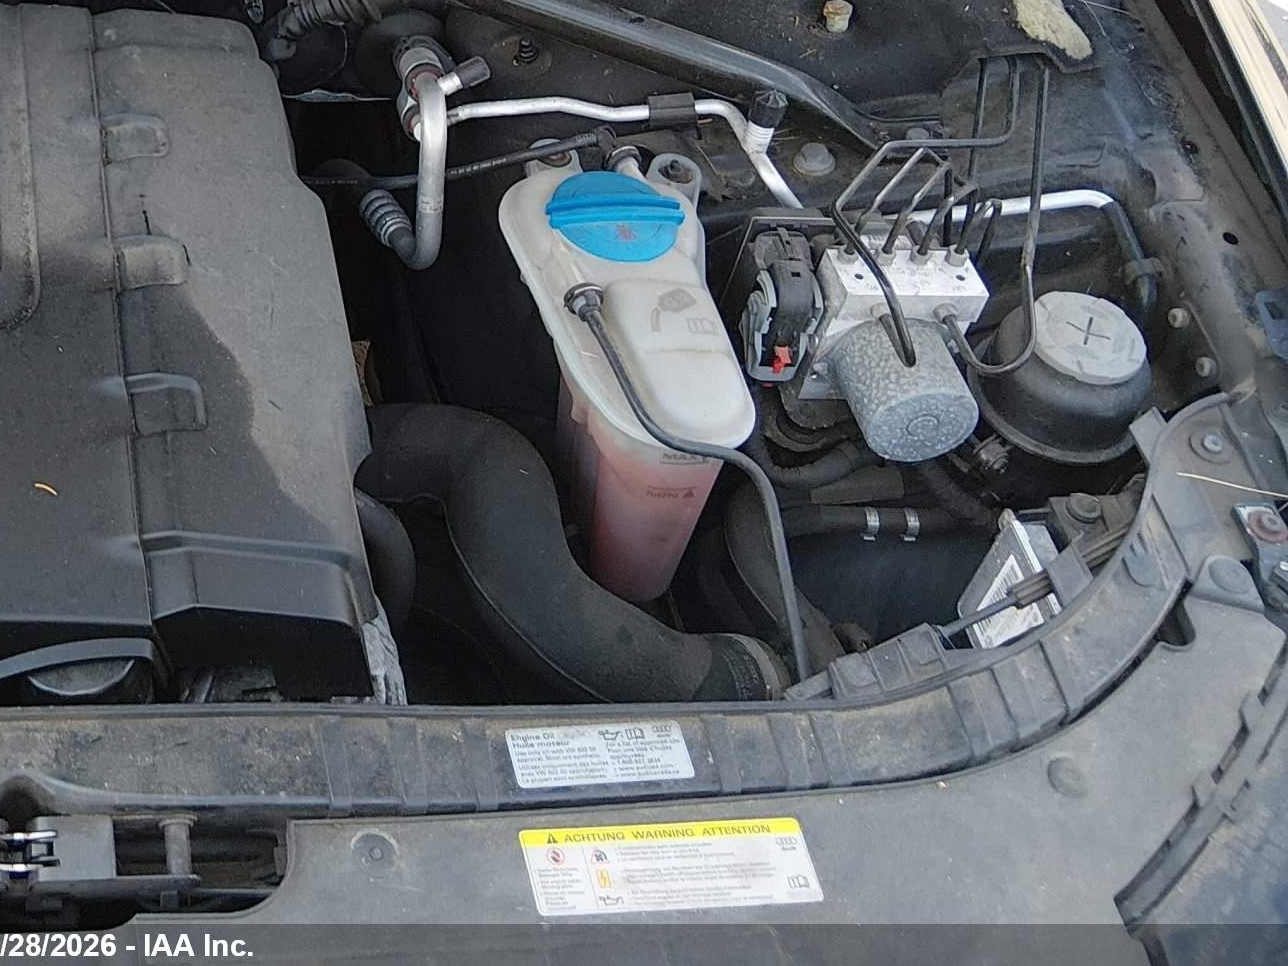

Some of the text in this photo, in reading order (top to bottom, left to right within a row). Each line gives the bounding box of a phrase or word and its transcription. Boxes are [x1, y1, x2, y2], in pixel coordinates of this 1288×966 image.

[510, 733, 541, 744] Engine
[542, 732, 555, 740] Oil
[564, 824, 772, 843] ACHTUNG WARNING ATTENTION
